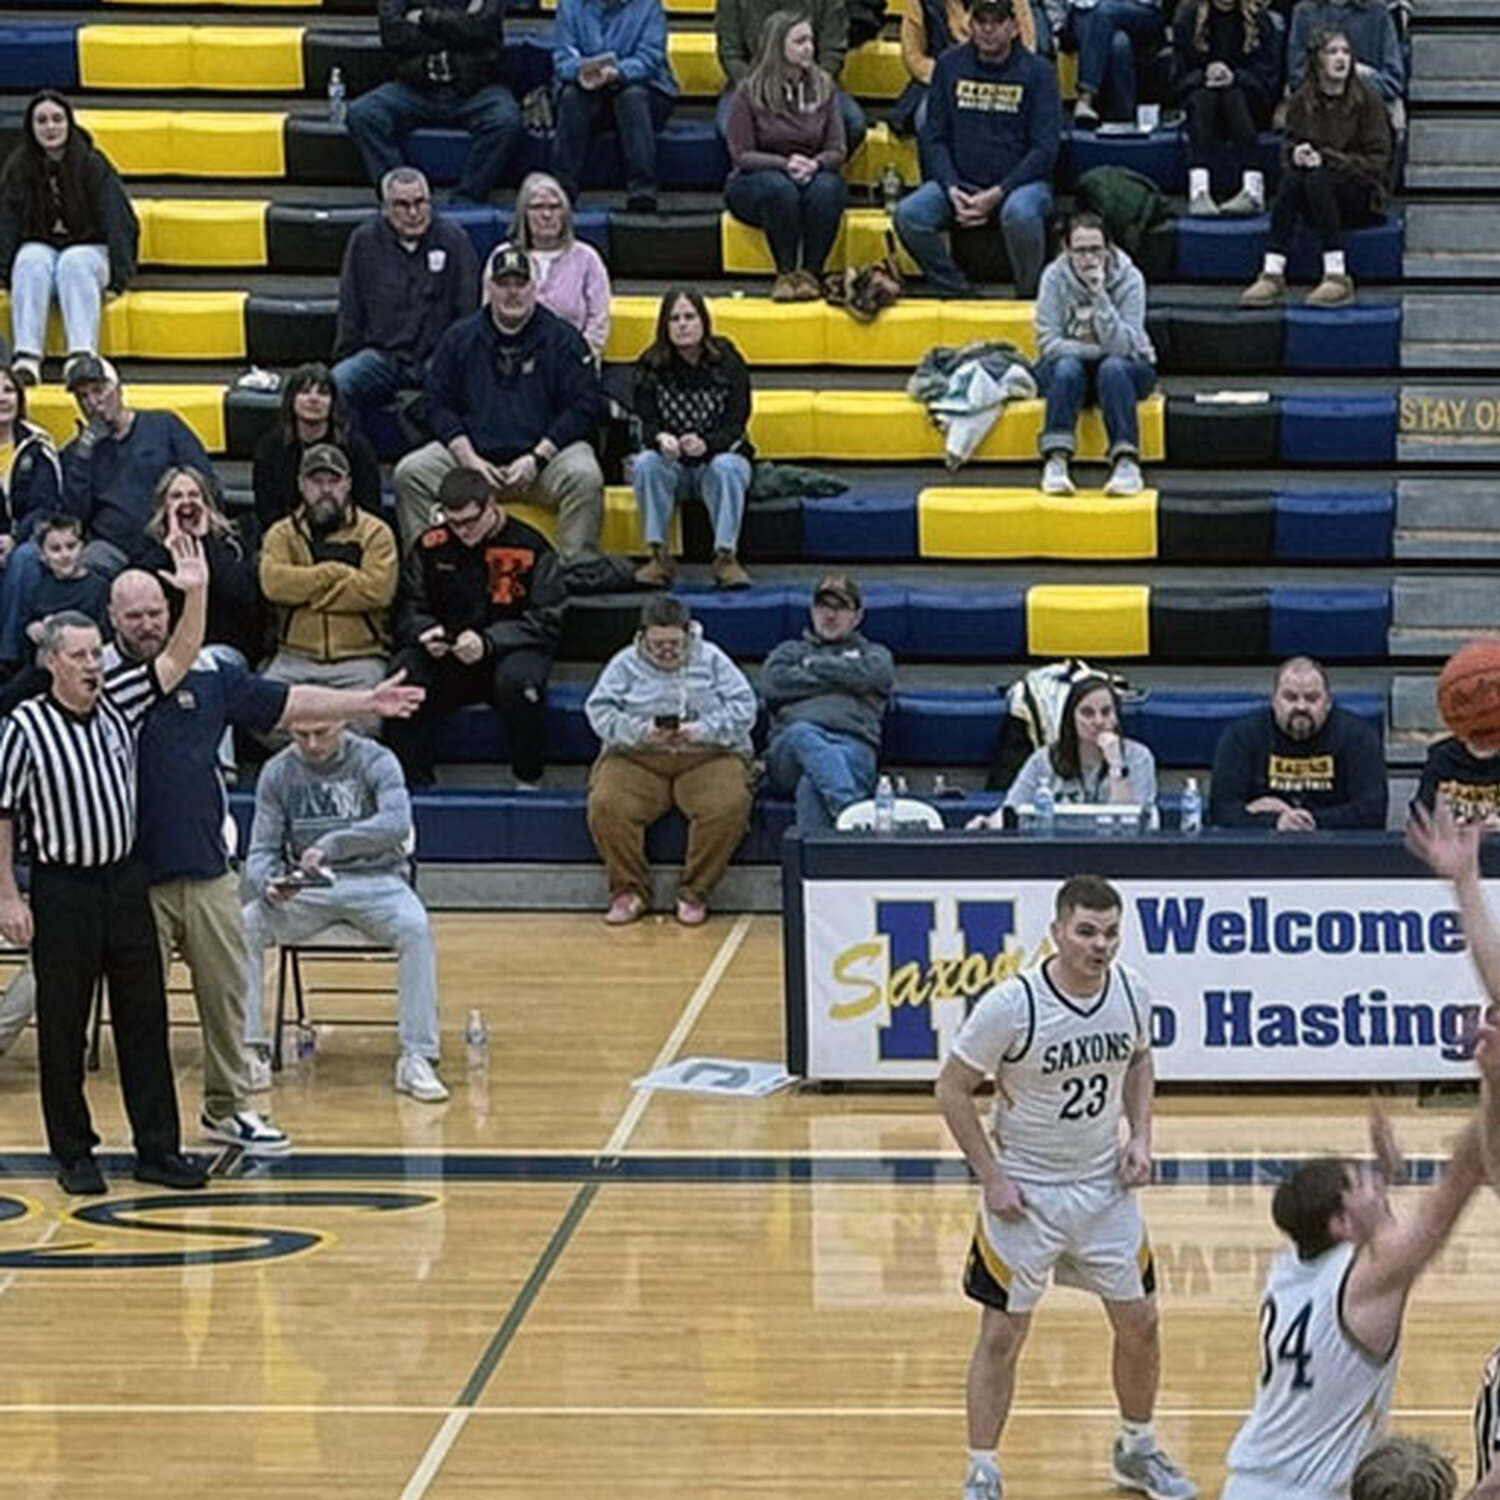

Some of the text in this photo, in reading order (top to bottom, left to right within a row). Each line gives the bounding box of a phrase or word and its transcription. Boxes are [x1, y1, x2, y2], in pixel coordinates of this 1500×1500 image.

[1400, 399, 1467, 431] STAY
[1137, 898, 1468, 955] Welcome
[1203, 990, 1500, 1061] Hasting
[1042, 1031, 1131, 1075] SAXONS
[1059, 1073, 1109, 1120] 23
